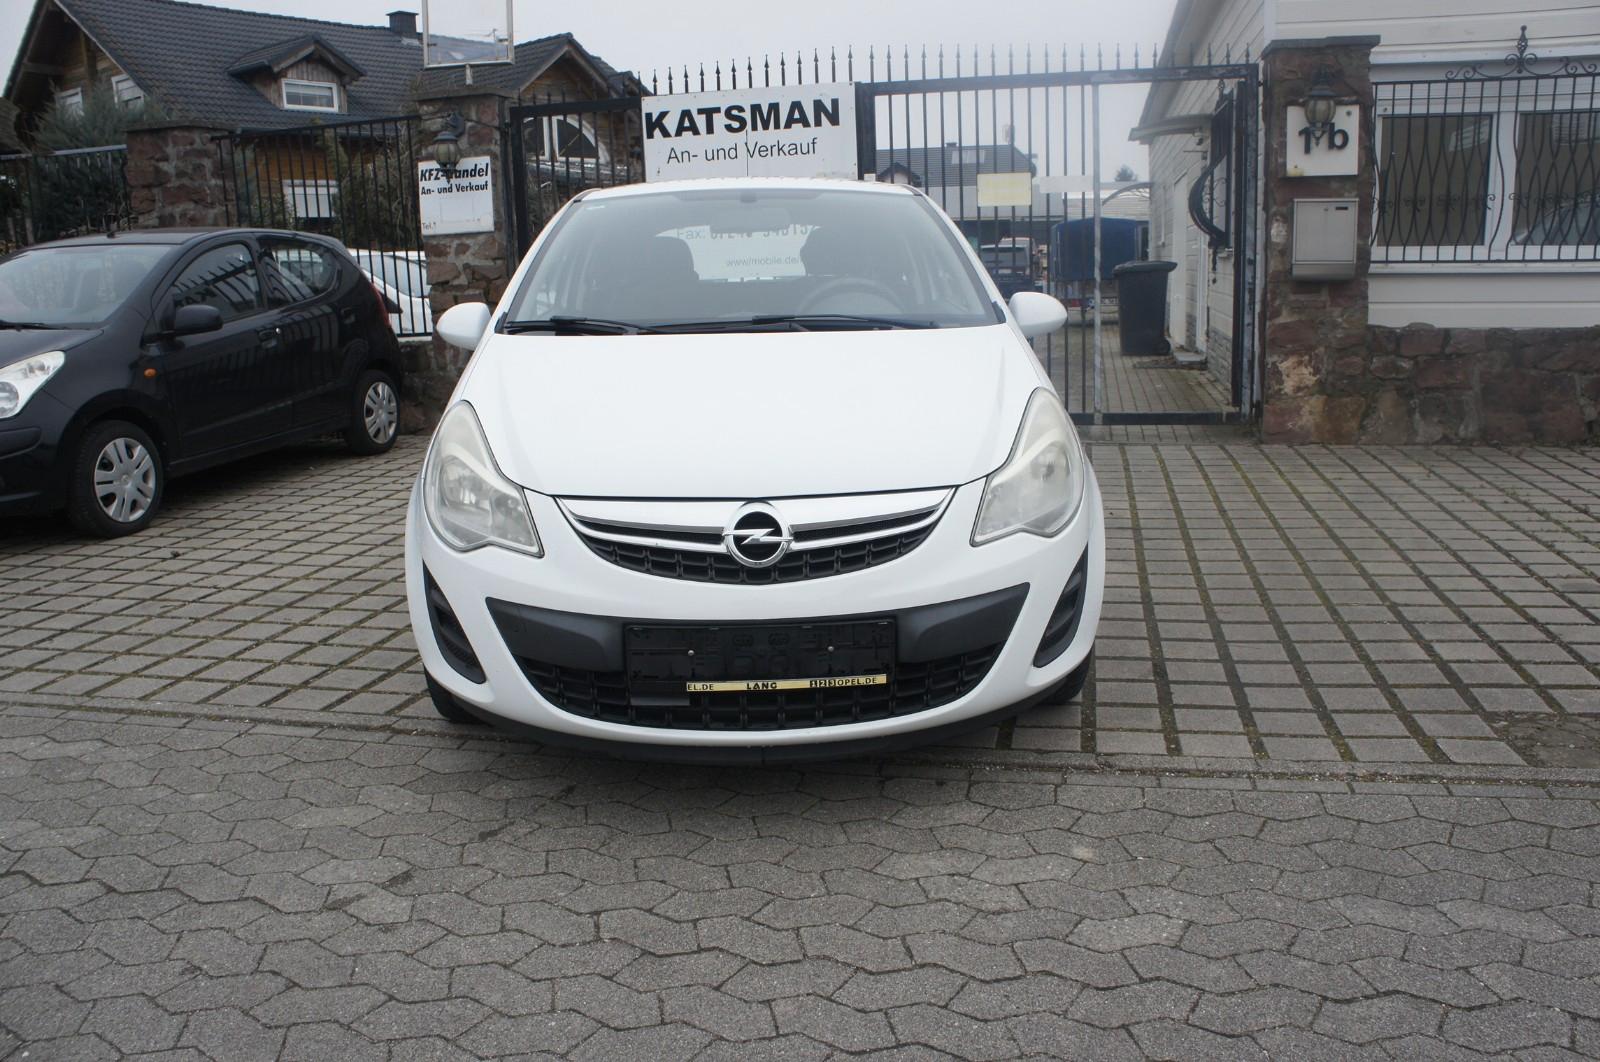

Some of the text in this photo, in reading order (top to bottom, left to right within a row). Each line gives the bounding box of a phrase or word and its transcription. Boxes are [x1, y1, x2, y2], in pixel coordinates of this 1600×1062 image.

[644, 98, 841, 140] KATSMAN
[667, 137, 818, 165] An- und Verkauf
[420, 180, 489, 196] An- und Verkauf
[746, 681, 778, 690] LANG
